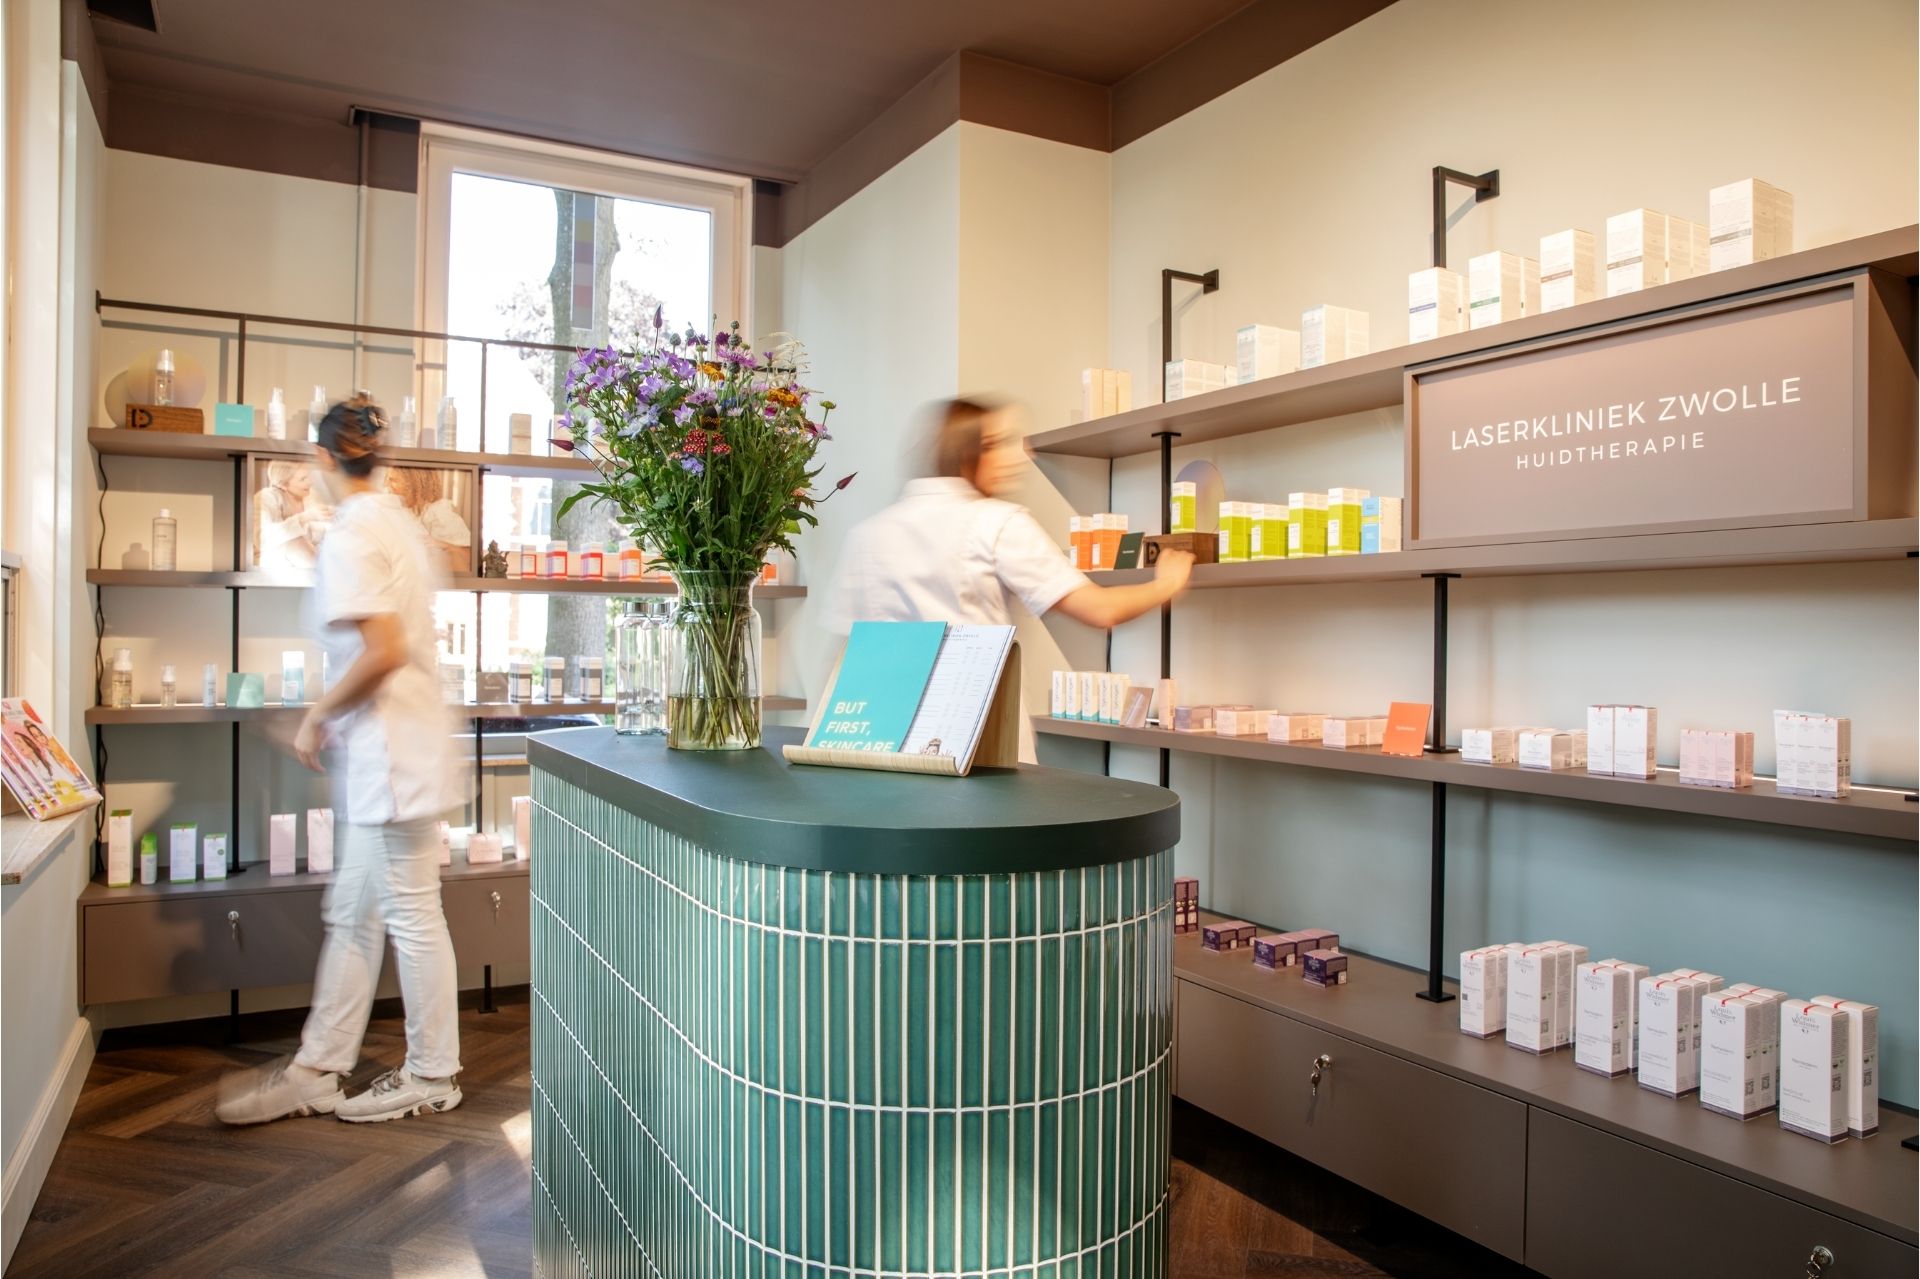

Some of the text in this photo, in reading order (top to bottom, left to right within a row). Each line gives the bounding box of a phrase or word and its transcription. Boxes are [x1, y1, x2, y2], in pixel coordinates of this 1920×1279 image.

[1452, 377, 1801, 450] LASERKLINIEK ZWOLLE
[1516, 432, 1705, 470] HUIDTHERAPIE
[834, 701, 867, 714] BUT
[825, 721, 871, 736] FIRST,
[818, 740, 895, 752] SKINCARE
